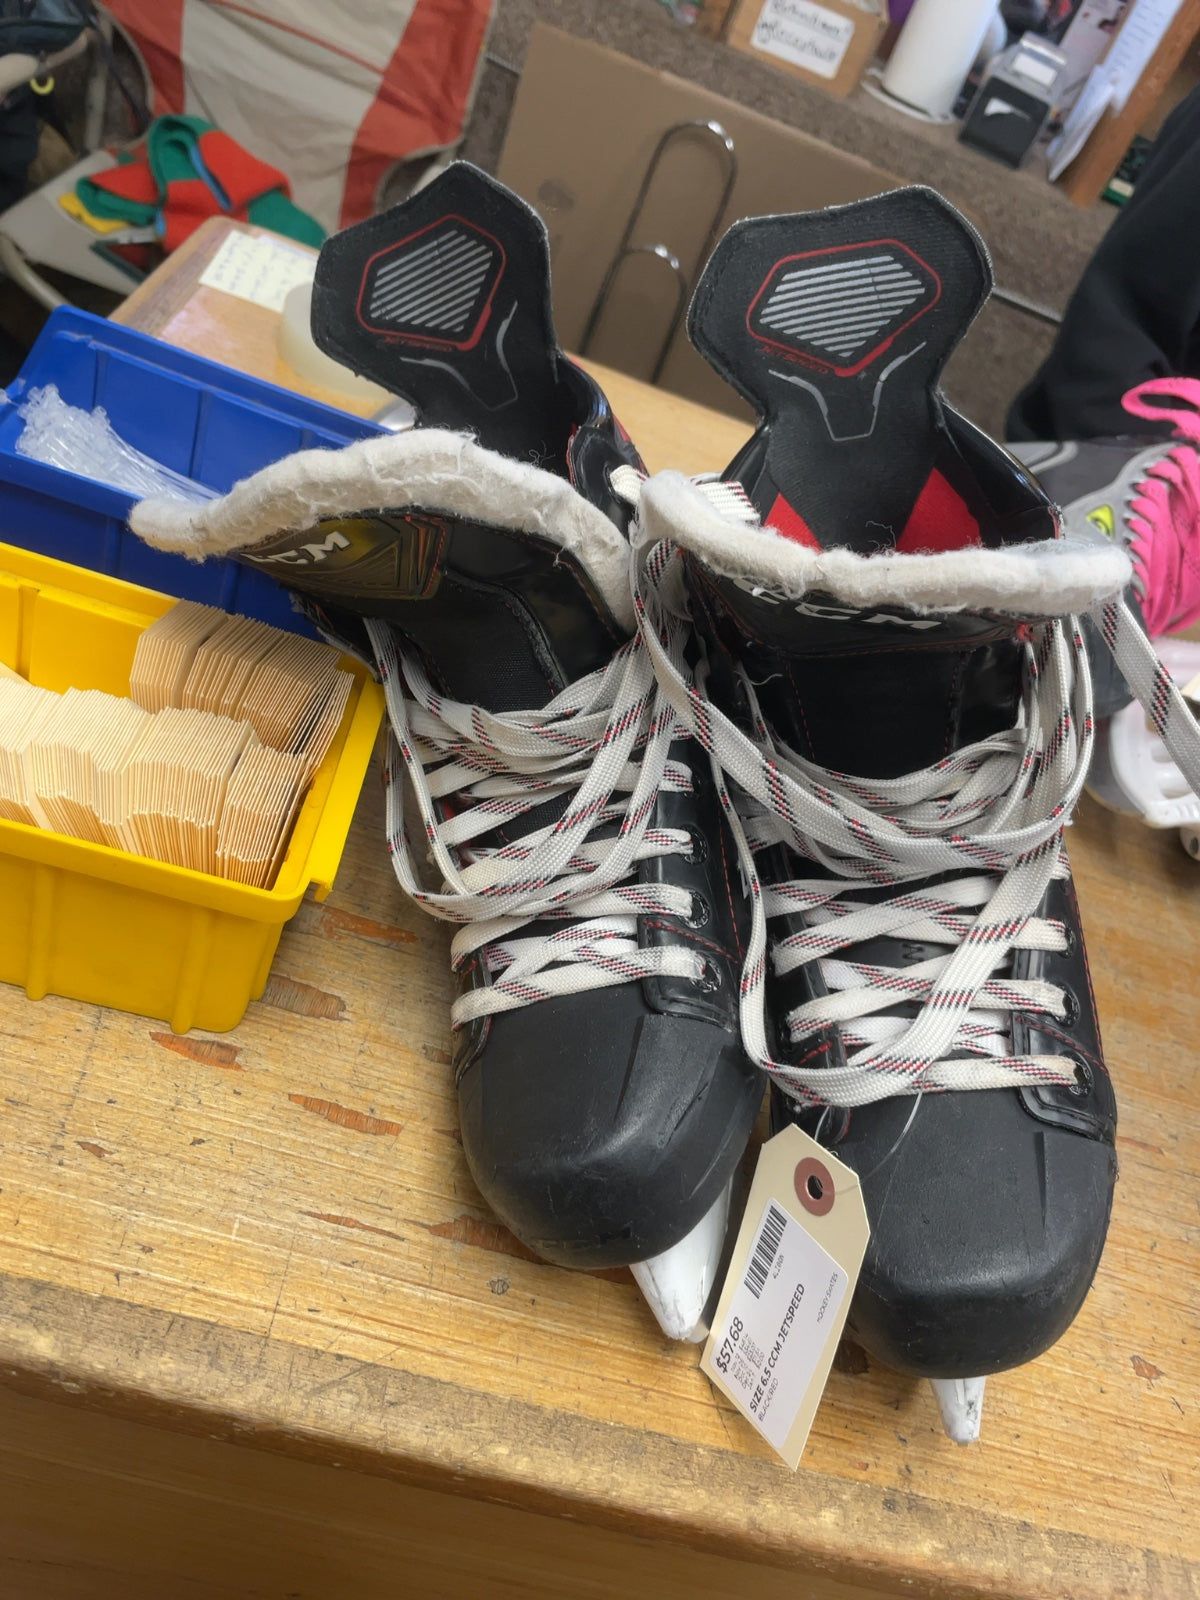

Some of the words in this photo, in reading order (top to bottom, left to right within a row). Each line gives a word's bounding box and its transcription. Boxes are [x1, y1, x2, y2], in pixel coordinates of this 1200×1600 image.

[715, 1316, 744, 1373] $57.68
[749, 1384, 765, 1413] SIZE
[760, 1366, 772, 1387] 6.5
[767, 1340, 783, 1369] CCM
[777, 1283, 805, 1343] JETSPEED
